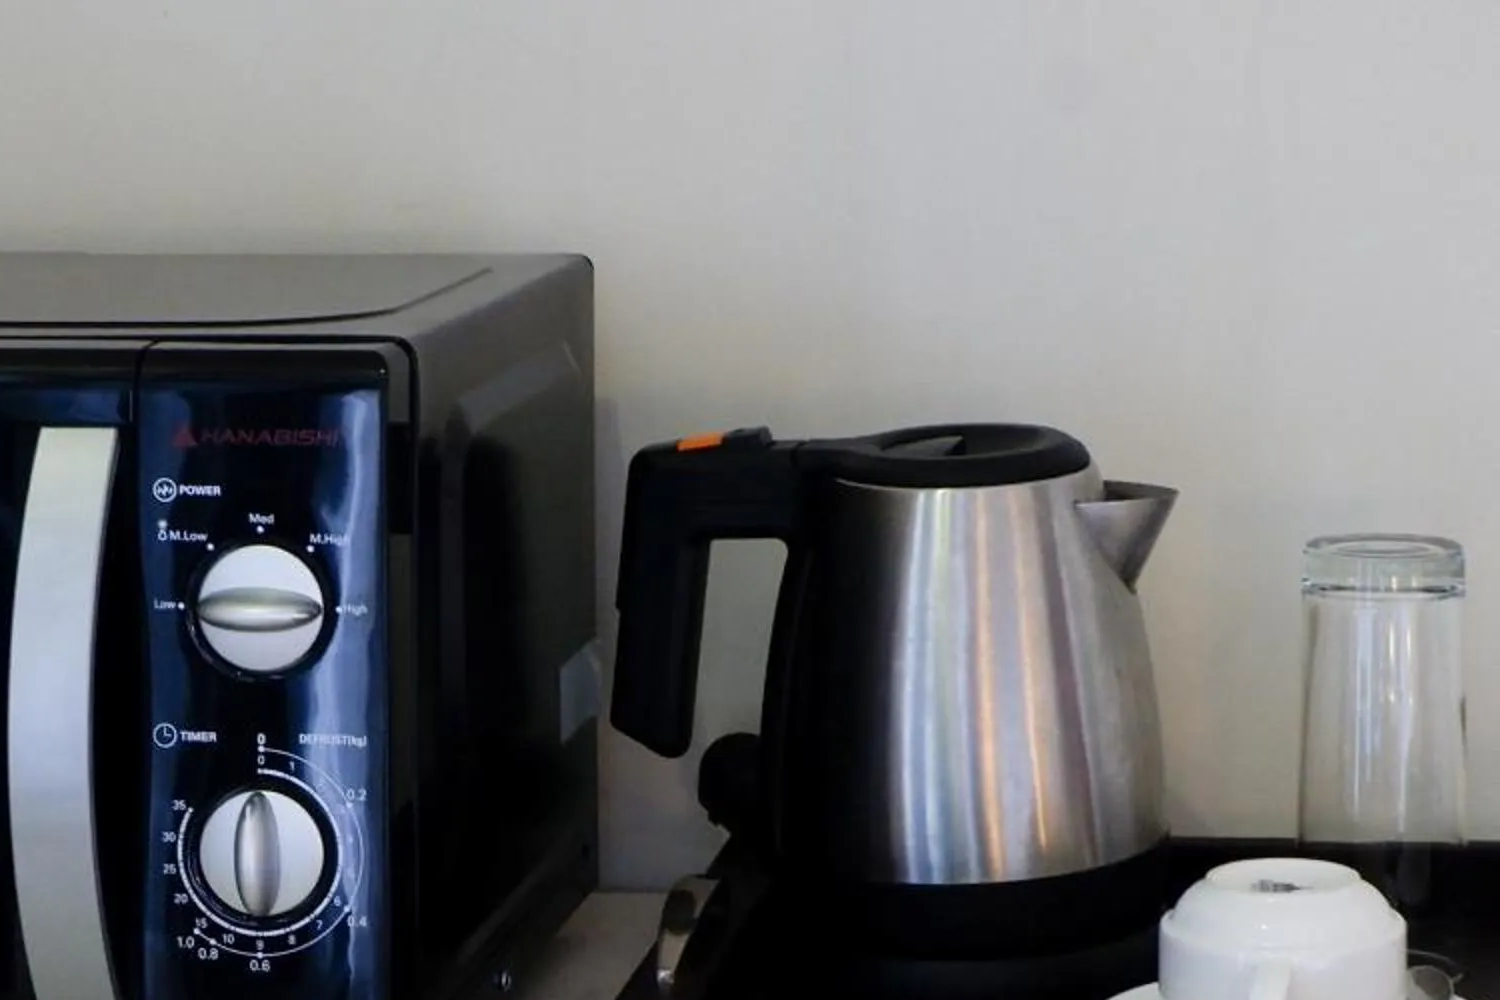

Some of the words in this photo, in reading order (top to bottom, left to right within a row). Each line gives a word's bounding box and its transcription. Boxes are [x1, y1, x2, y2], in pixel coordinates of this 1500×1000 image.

[179, 486, 221, 496] POWER
[249, 513, 274, 524] Med
[170, 531, 207, 541] M.Low
[154, 600, 176, 609] Low
[180, 732, 217, 743] TIMER
[256, 733, 266, 744] 0
[257, 756, 265, 765] 0
[172, 800, 186, 811] 35
[163, 832, 176, 842] 30
[164, 863, 176, 873] 25
[174, 894, 188, 904] 20
[177, 936, 195, 948] 1.0
[223, 933, 235, 944] 10
[198, 948, 219, 960] 0.8
[249, 960, 271, 972] 0.6
